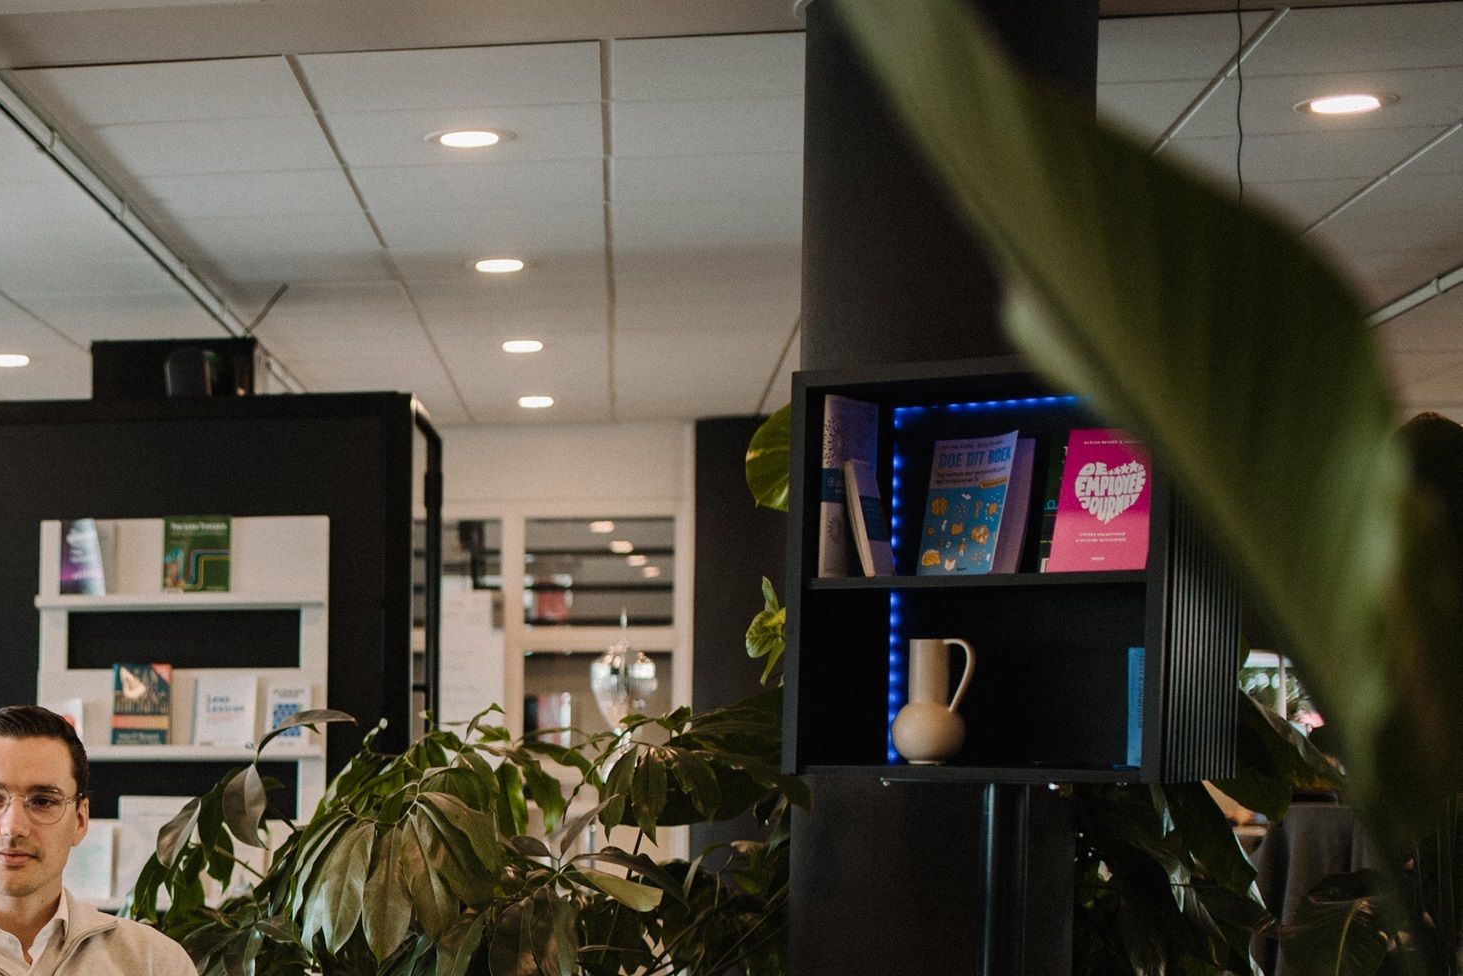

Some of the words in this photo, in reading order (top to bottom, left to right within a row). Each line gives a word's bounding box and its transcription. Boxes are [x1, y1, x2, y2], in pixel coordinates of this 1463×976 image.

[1075, 469, 1146, 498] EMPLOYEE
[1078, 462, 1108, 476] DE
[1078, 493, 1140, 524] JOURNEY
